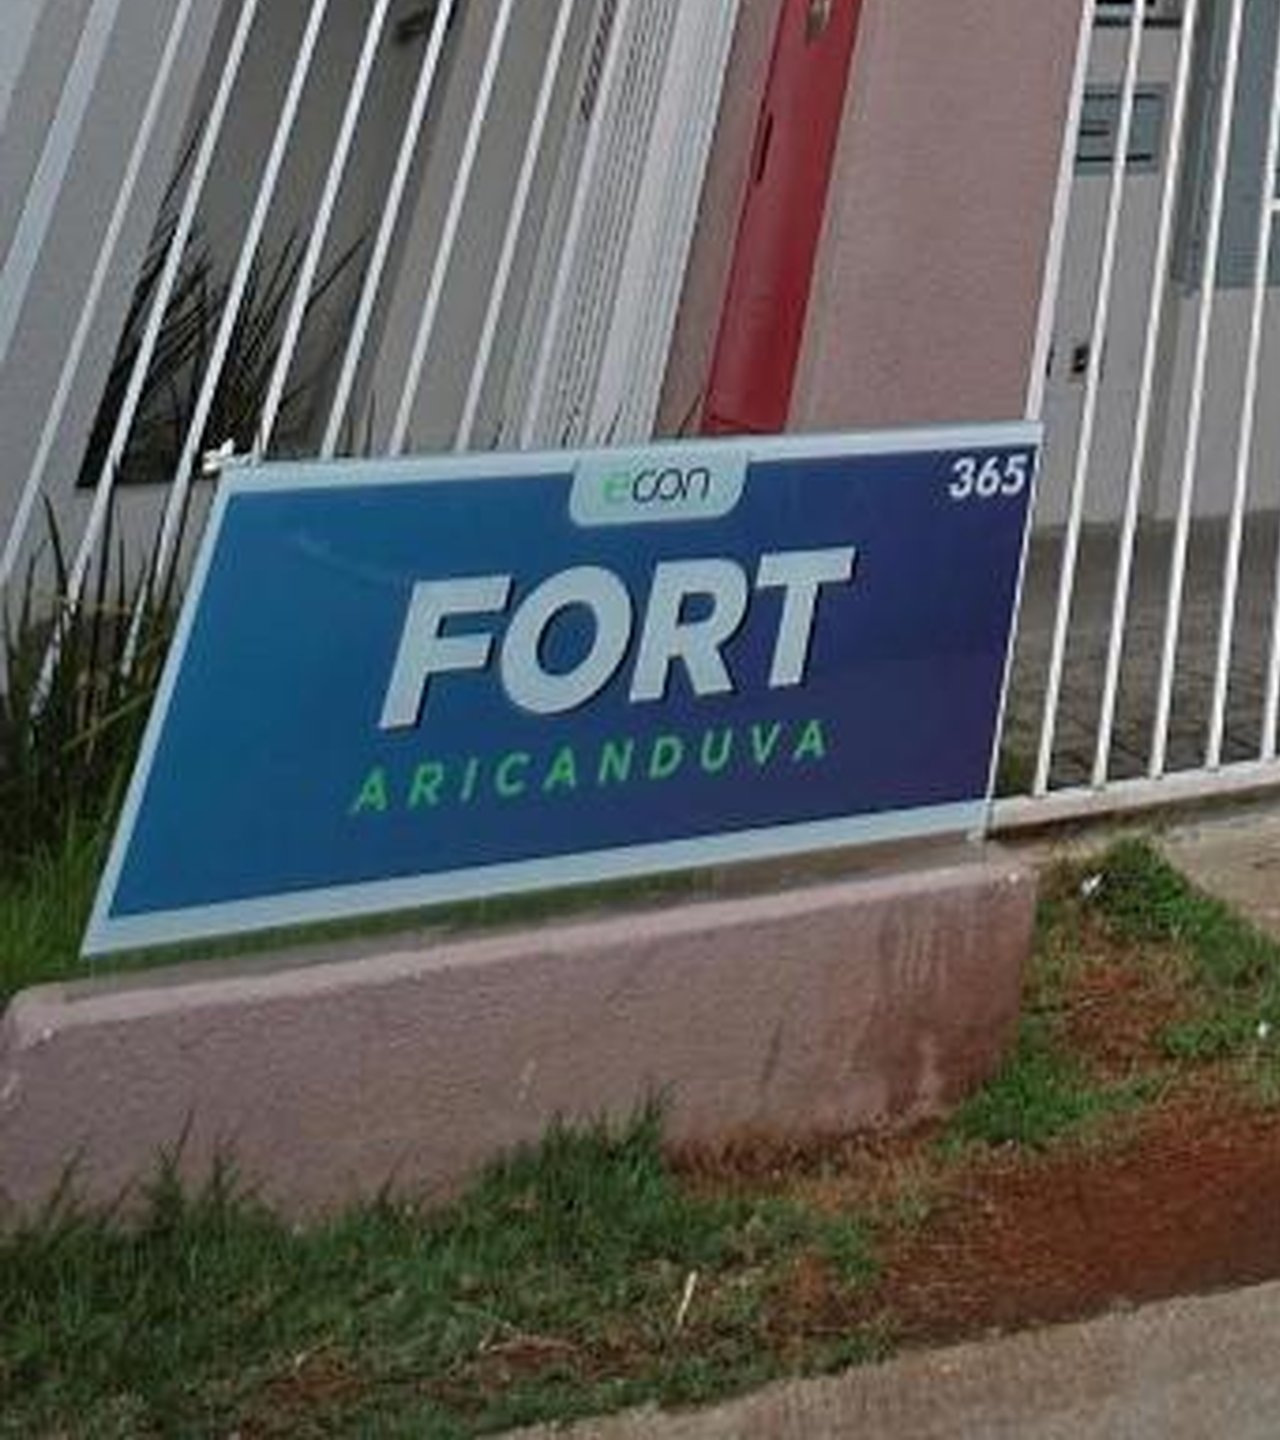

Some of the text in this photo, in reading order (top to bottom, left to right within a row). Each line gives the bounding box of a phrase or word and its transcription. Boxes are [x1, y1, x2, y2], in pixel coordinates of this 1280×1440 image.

[949, 454, 1028, 498] 365
[378, 546, 858, 732] FORT
[352, 719, 827, 814] ARICANDUVA
